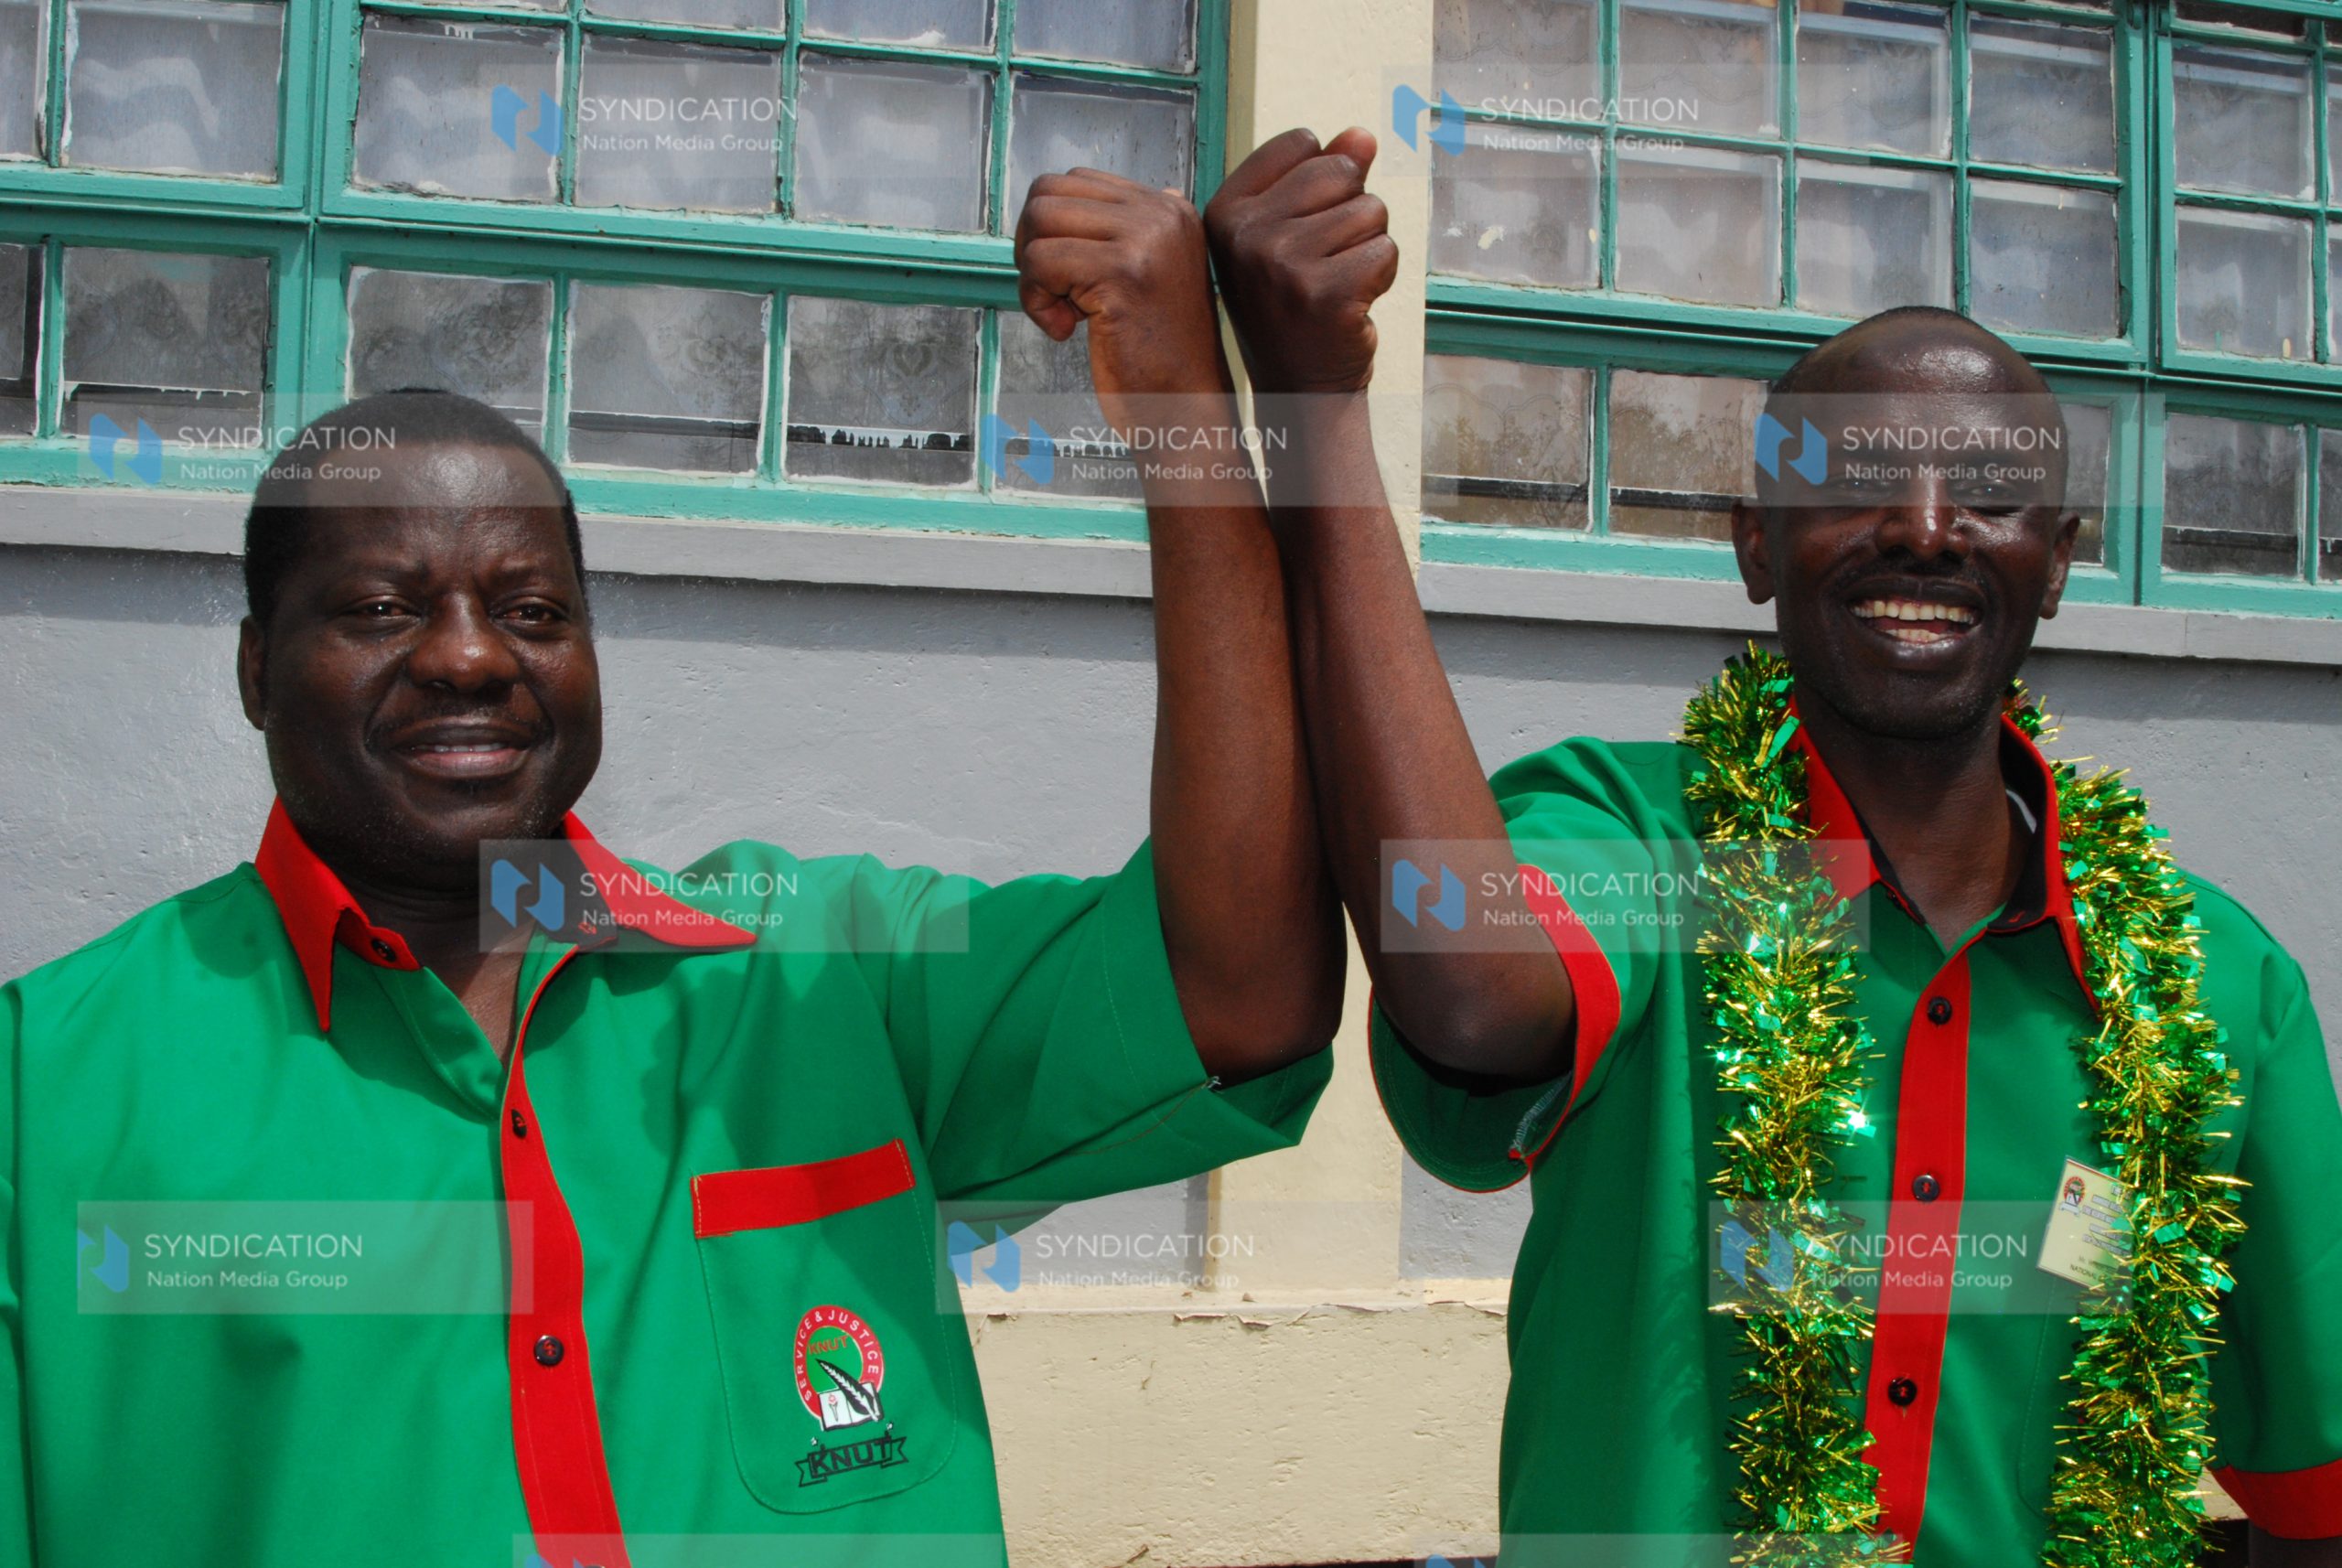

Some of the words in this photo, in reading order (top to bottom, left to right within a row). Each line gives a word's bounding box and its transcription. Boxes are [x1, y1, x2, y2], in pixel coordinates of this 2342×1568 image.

[796, 1318, 812, 1401] SERVICE
[814, 1310, 823, 1323] &
[828, 1310, 879, 1374] JUSTICE
[809, 1335, 848, 1356] KNUT
[810, 1438, 893, 1479] KNUT
